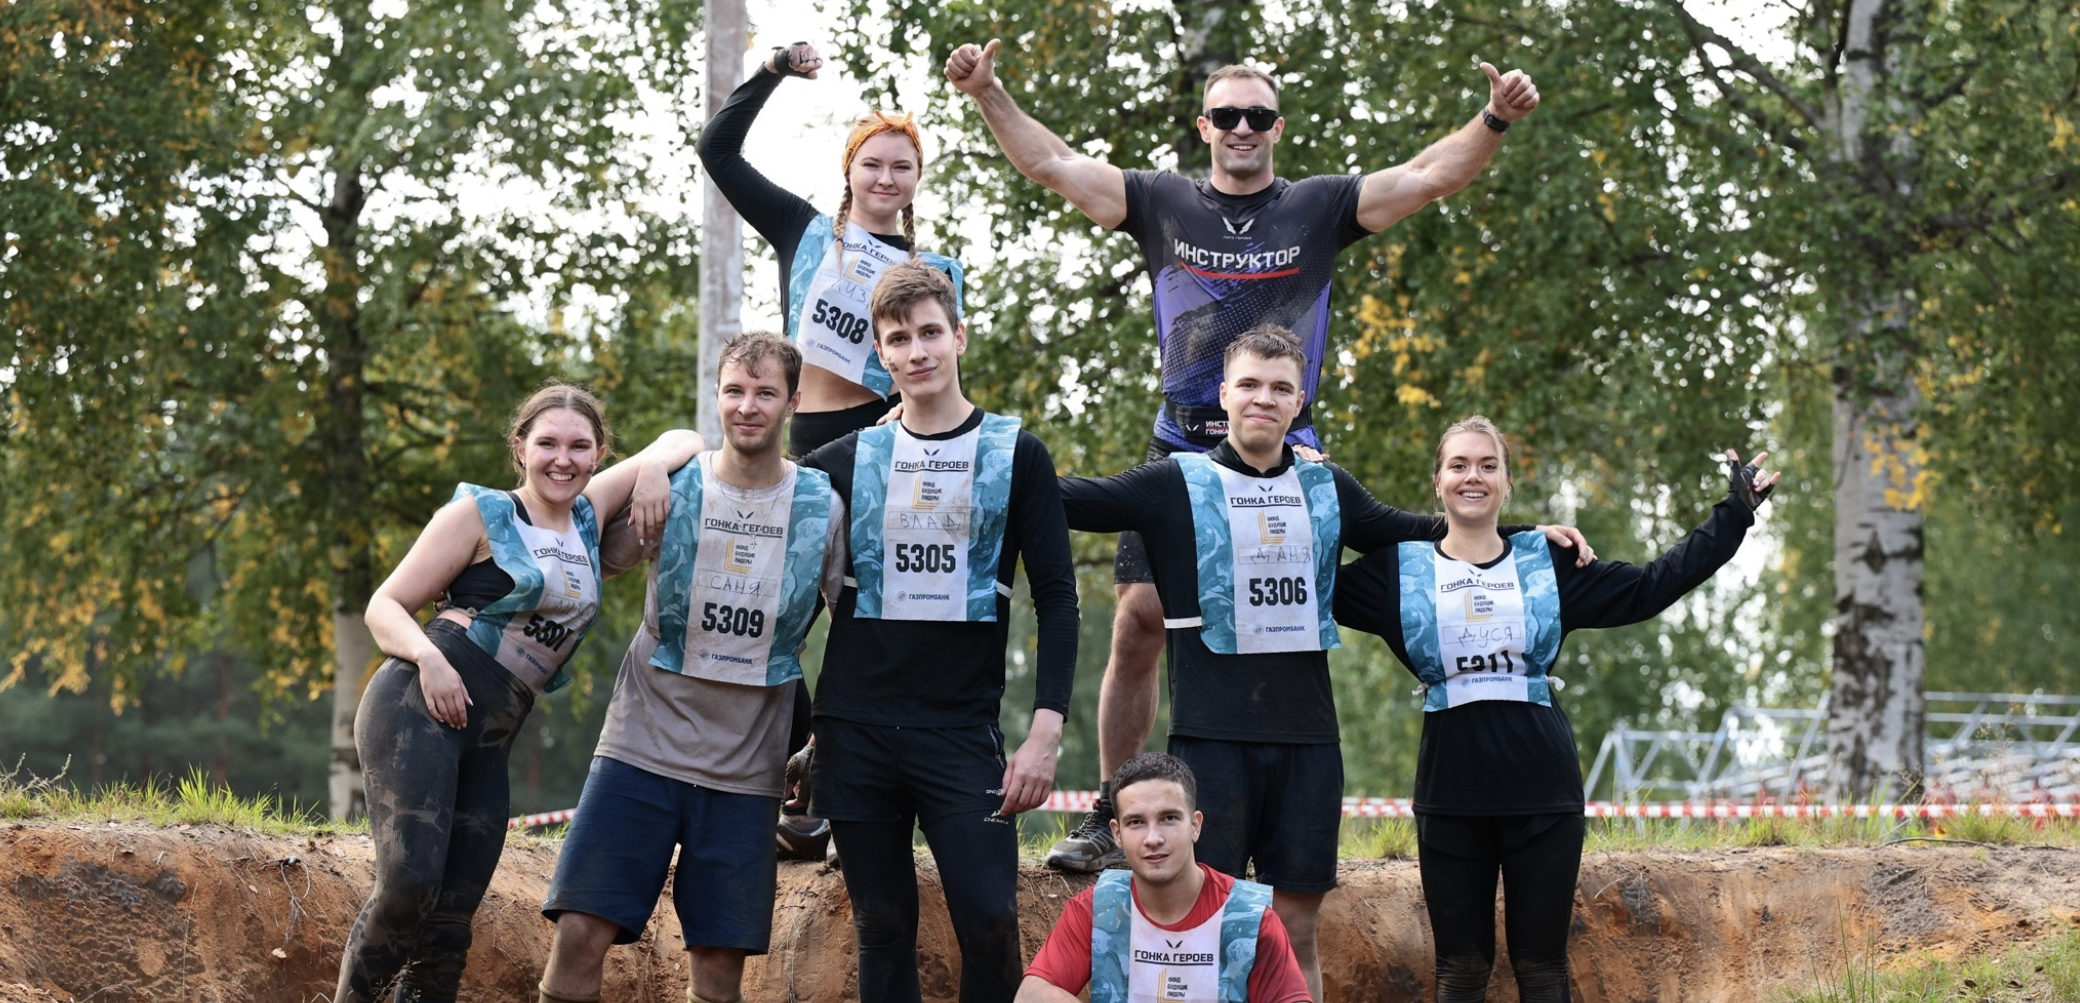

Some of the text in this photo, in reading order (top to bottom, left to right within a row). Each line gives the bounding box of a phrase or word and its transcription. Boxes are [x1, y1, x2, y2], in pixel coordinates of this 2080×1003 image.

[843, 241, 867, 251] ОНКА
[1174, 238, 1300, 269] ИНСТРУКТОР
[812, 298, 869, 345] 5308
[894, 460, 969, 470] ГОНКА ГЕРОЕВ
[1230, 495, 1301, 505] ГОНКА ГЕРОЕВ
[705, 518, 783, 535] ГОНКА ГЕРОЕВ
[900, 513, 961, 531] ВЛАД
[561, 551, 588, 563] ГЕРОЕВ
[895, 543, 956, 573] 5305
[1250, 546, 1311, 565] ДАНЯ
[710, 575, 761, 598] САНЯ
[1249, 576, 1307, 607] 5306
[1440, 578, 1514, 590] ГОНКА ГЕРОЕВ
[908, 593, 950, 601] ГАЗПРОМБАНК
[701, 602, 765, 638] 5309
[1265, 625, 1306, 633] ГАЗПРОМБАНК
[1457, 626, 1513, 648] ДУСЯ
[711, 653, 753, 665] ГАЗПРОМБАНК
[1471, 676, 1513, 684] ГАЗПРОМБАНК
[1134, 949, 1214, 962] ГОНКА ГЕРОЕВ
